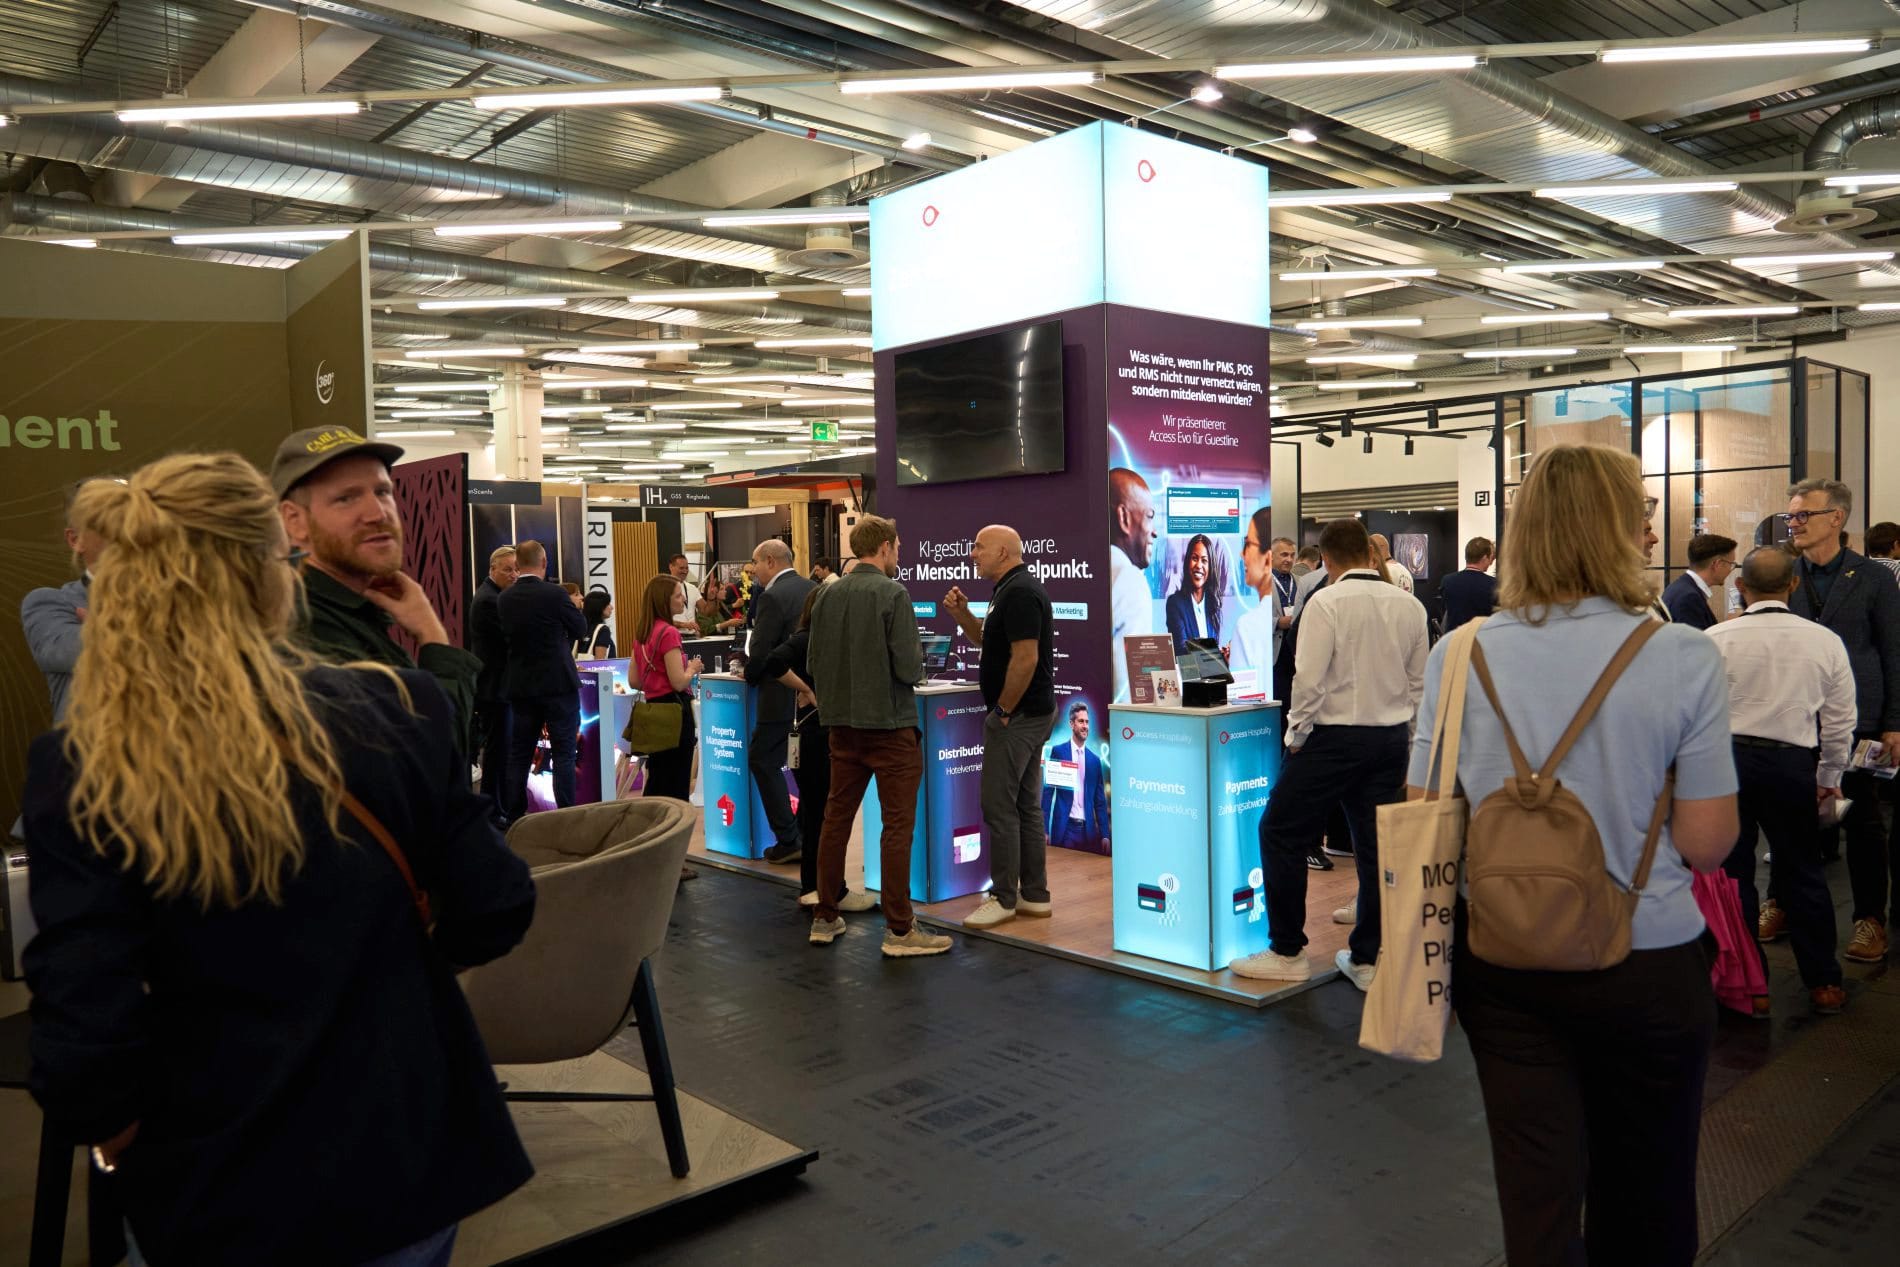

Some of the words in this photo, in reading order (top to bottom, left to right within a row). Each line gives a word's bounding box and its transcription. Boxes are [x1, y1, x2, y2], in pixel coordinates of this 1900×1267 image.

[1130, 350, 1149, 364] Was
[1151, 353, 1176, 369] wäre,
[1177, 358, 1201, 370] wenn
[1203, 359, 1215, 372] Ihr
[1216, 361, 1236, 375] PMS,
[1237, 364, 1253, 376] POS
[1119, 367, 1137, 379] und
[1139, 367, 1159, 381] RMS
[1160, 370, 1183, 384] nicht
[1184, 375, 1199, 386] nur
[1201, 377, 1235, 390] vernetzt
[1236, 379, 1263, 395] wären,
[1132, 385, 1169, 398] sondern
[1170, 388, 1216, 403] mitdenken
[1218, 392, 1252, 406] würden?
[1162, 414, 1176, 427] Wir
[1177, 416, 1227, 431] präsentieren:
[1149, 430, 1176, 443] Access
[1178, 432, 1191, 444] Evo
[1193, 432, 1203, 445] für
[1204, 433, 1239, 447] Guestline
[919, 538, 975, 562] KI-gestüt
[1021, 538, 1058, 554] ware.
[917, 561, 970, 581] Mensch
[1027, 559, 1093, 584] elpunkt.
[1055, 607, 1084, 616] Marketing
[948, 707, 966, 715] access
[712, 725, 736, 739] Property
[1136, 730, 1158, 739] access
[705, 735, 743, 749] Management
[713, 747, 735, 759] System
[938, 744, 985, 761] Distributio
[1129, 776, 1186, 796] Payments
[1225, 776, 1269, 796] Payments
[1119, 796, 1198, 820] Zahlungsabwicklung
[1422, 862, 1458, 889] MO
